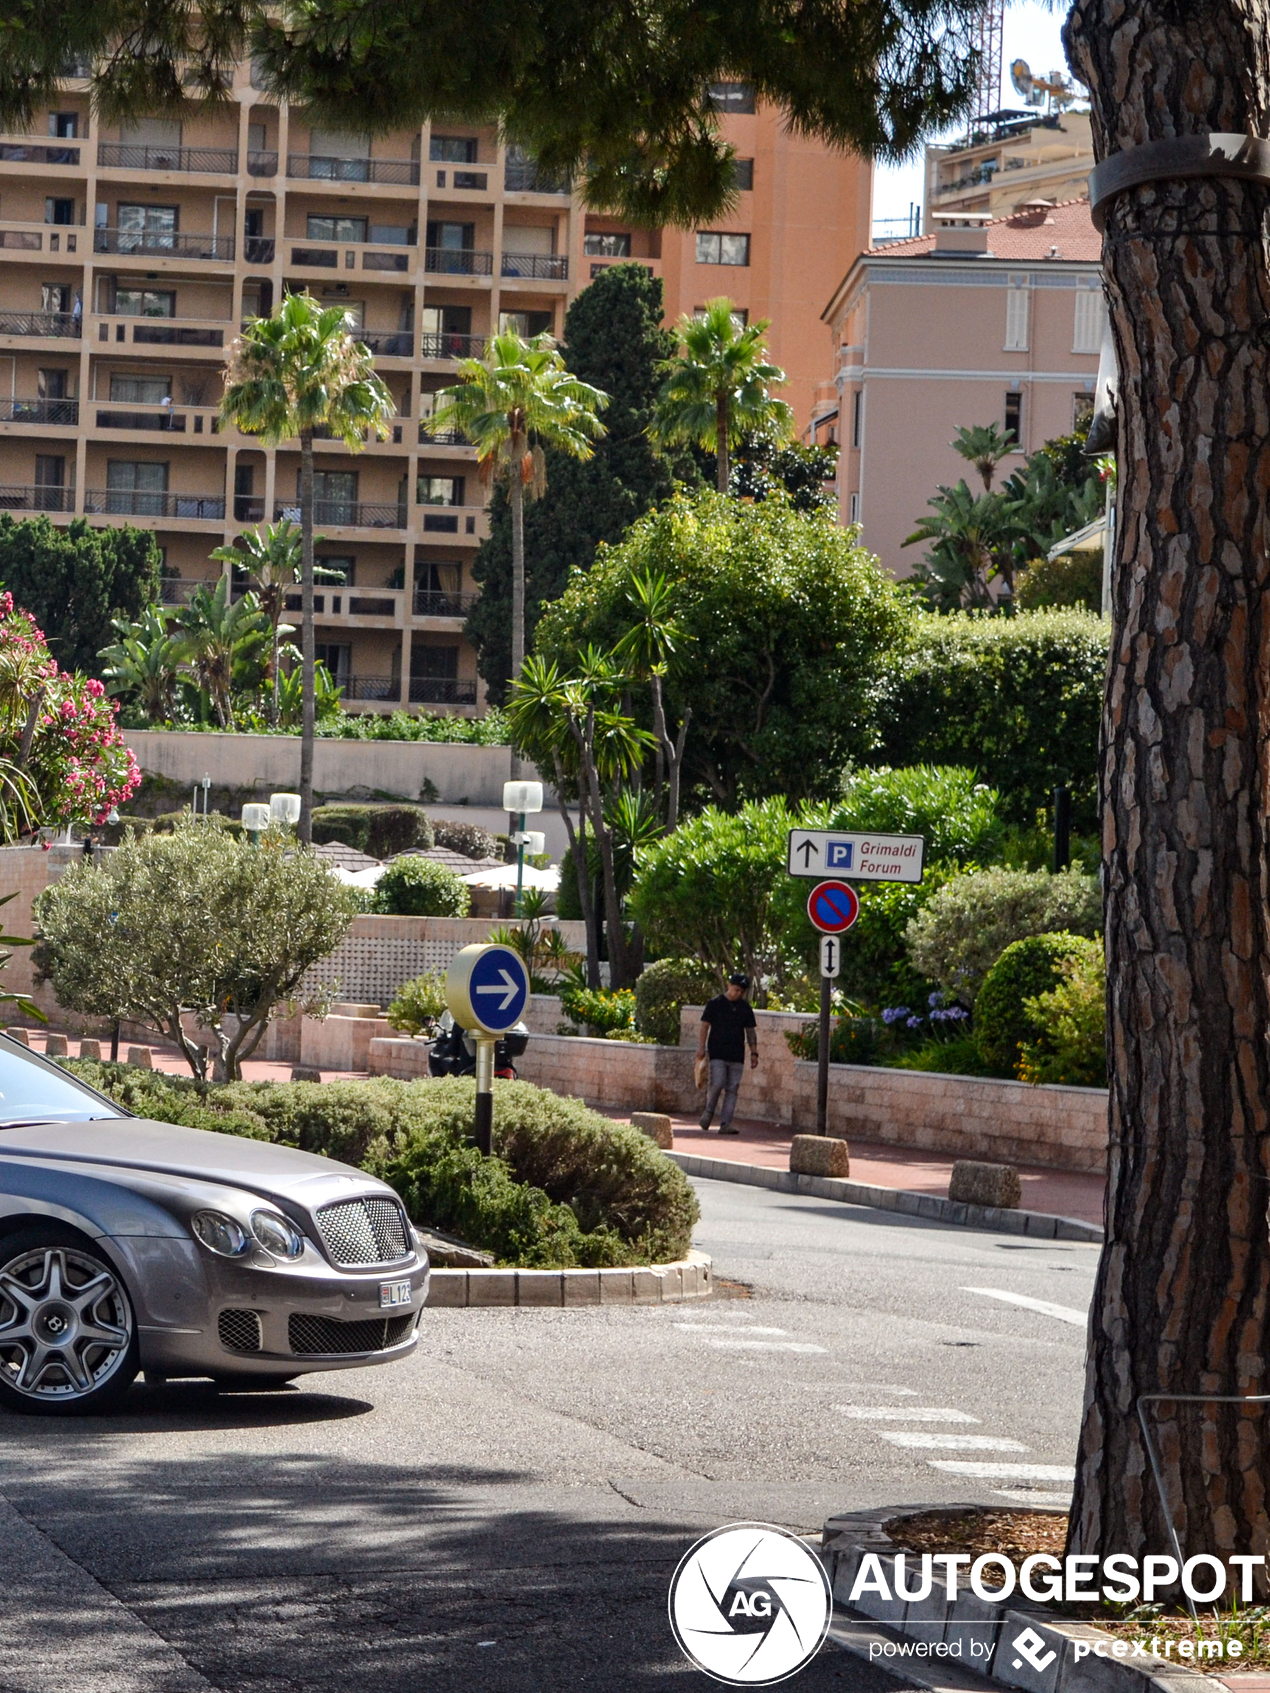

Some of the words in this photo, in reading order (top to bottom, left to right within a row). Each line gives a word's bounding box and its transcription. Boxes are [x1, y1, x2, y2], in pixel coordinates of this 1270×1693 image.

[832, 846, 847, 864] P
[860, 841, 917, 857] Grimaldi
[859, 859, 901, 875] Forum
